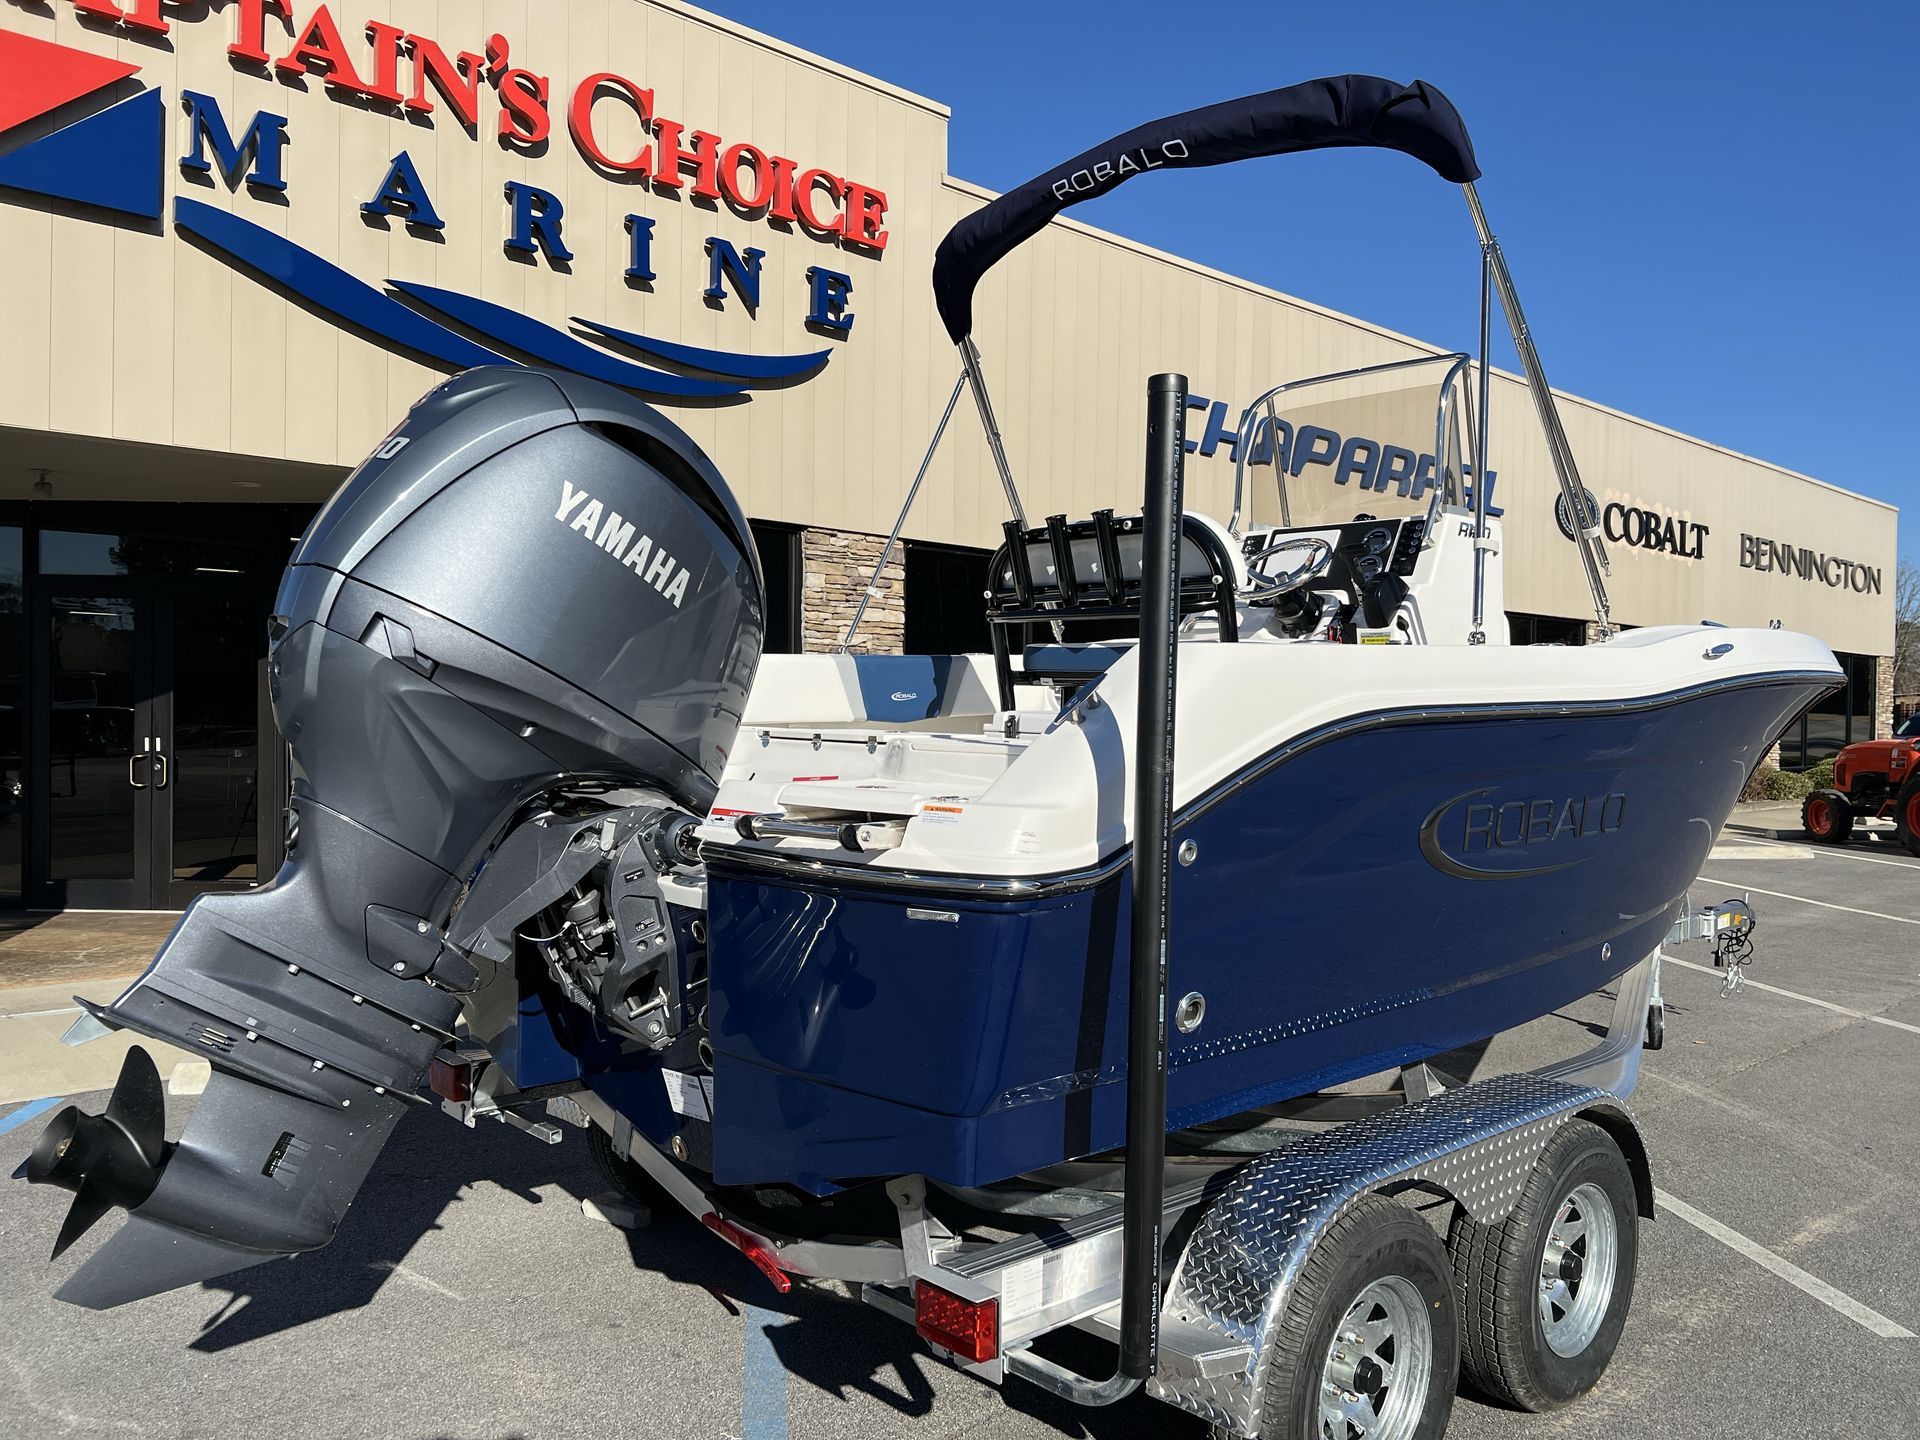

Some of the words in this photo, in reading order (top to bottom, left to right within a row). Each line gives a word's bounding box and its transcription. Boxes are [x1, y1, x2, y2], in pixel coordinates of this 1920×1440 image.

[567, 72, 889, 250] CHOICE
[1052, 139, 1189, 200] ROBALO
[178, 88, 855, 332] MARINE
[555, 480, 690, 608] YAMAHA
[1603, 502, 1710, 560] COBALT
[1740, 533, 1882, 595] BENNINGTON
[1462, 792, 1628, 852] ROBALO
[1149, 1282, 1158, 1358] CHARLOTTE
